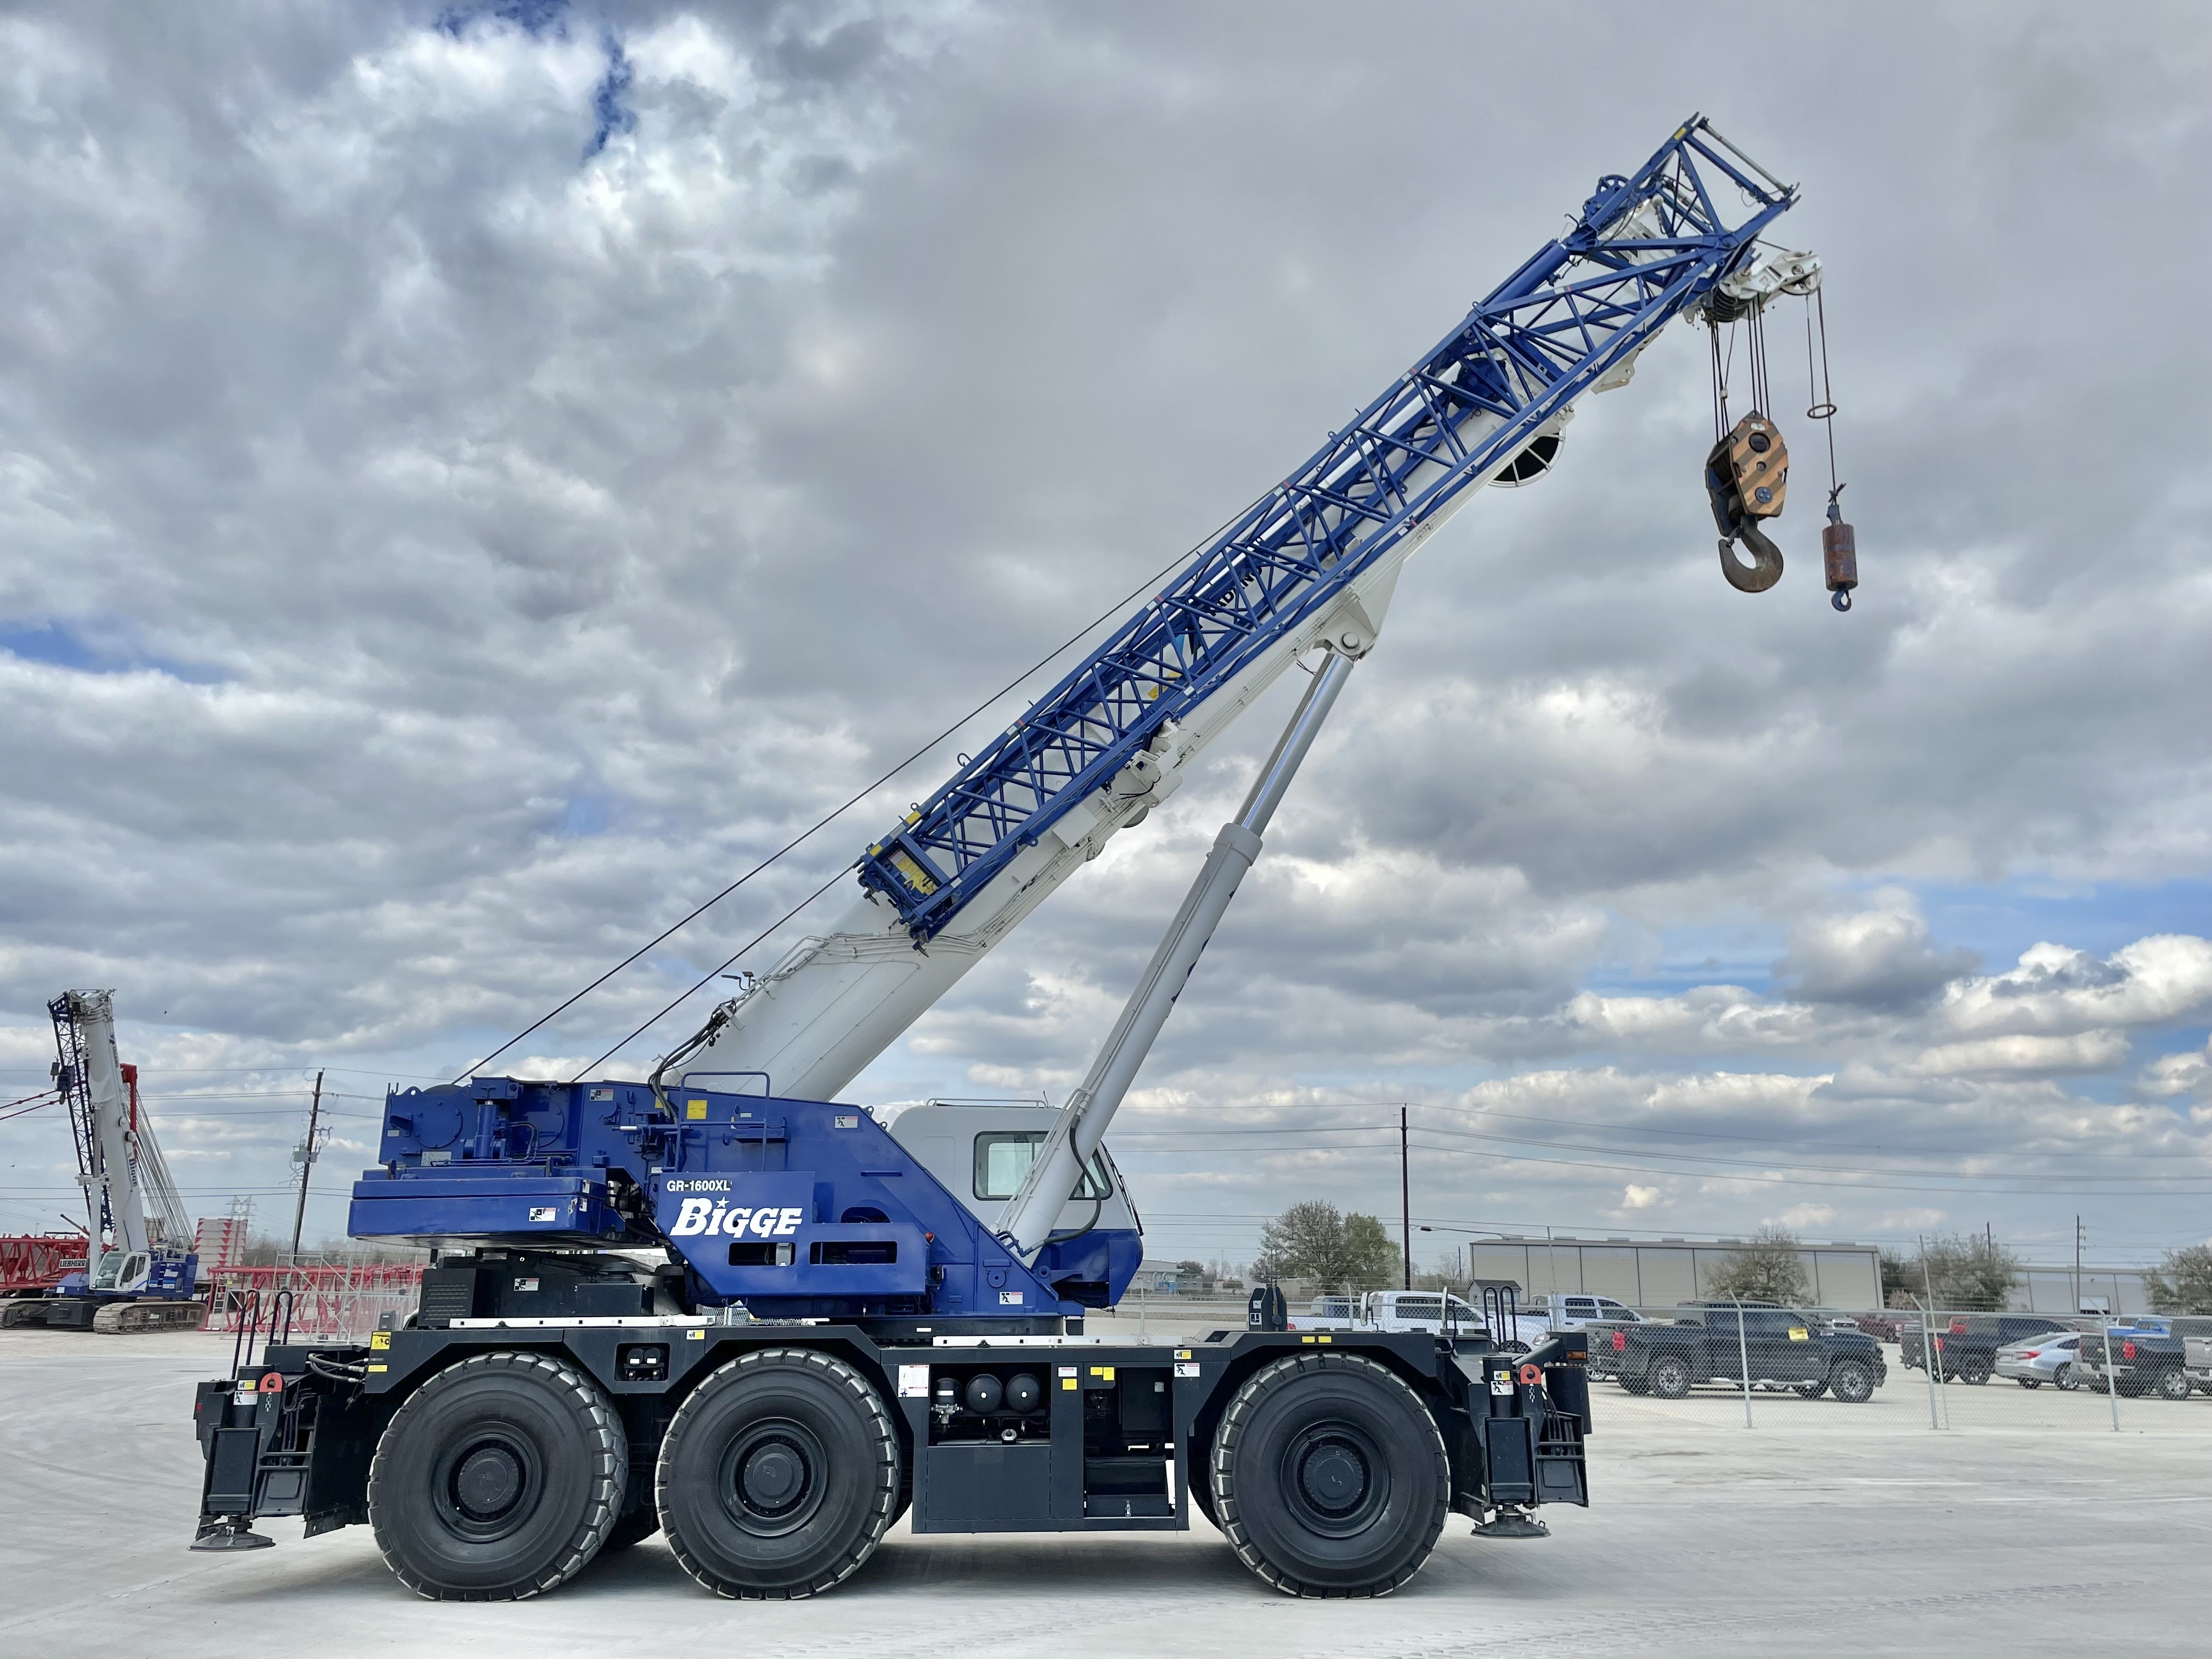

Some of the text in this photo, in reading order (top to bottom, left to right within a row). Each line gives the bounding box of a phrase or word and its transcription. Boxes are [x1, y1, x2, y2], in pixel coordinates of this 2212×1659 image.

[1209, 567, 1262, 617] ADN
[667, 1180, 731, 1192] GR-1600XL
[669, 1197, 803, 1238] BIGGE
